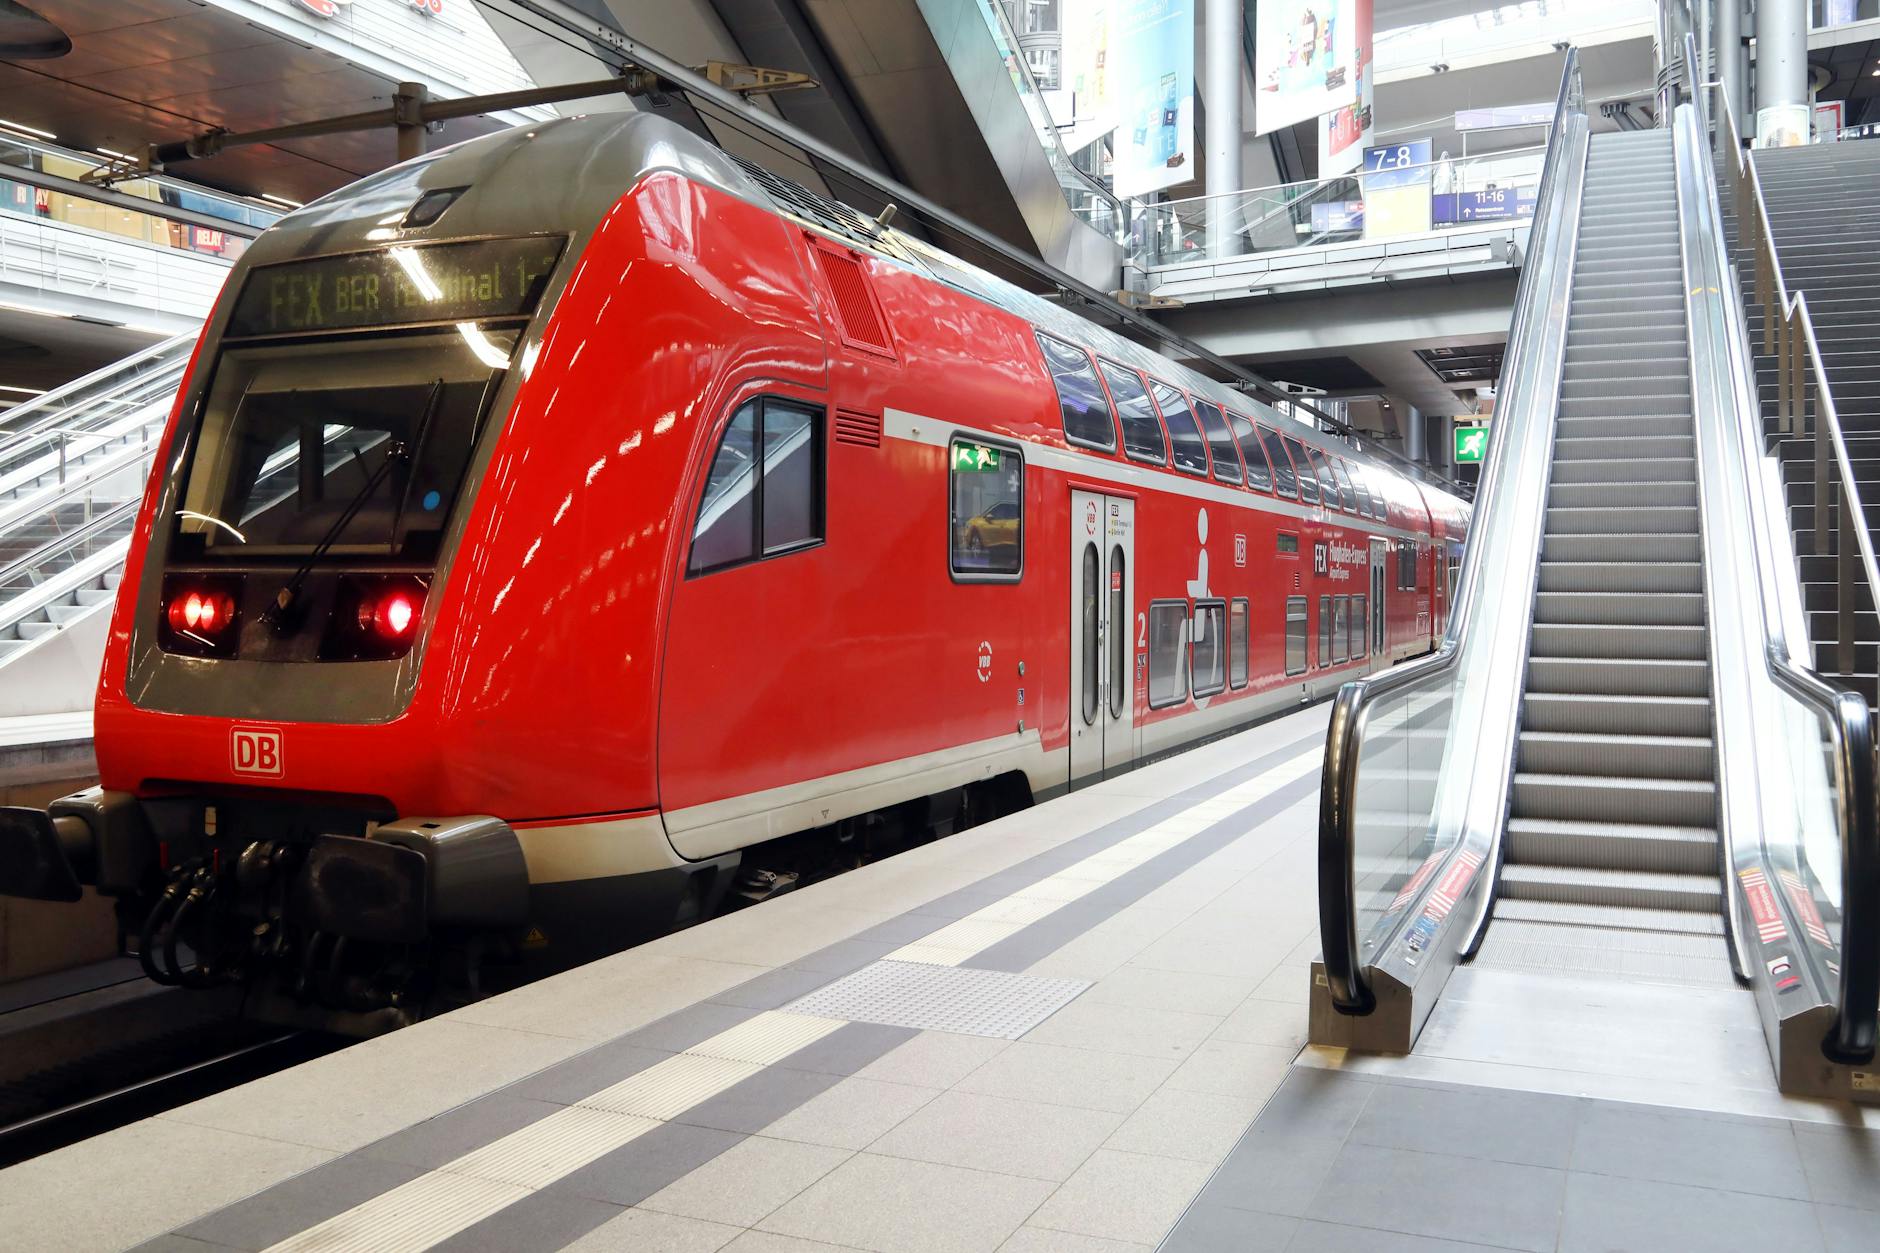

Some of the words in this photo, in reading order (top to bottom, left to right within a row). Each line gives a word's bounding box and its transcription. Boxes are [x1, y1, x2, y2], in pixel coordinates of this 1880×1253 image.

[1373, 146, 1411, 171] 7-8
[1475, 190, 1505, 204] 11-16
[196, 226, 223, 246] RELAY
[269, 273, 323, 328] FEX
[335, 273, 379, 313] BER
[1236, 540, 1245, 561] DB
[1314, 543, 1327, 574] FEX
[1137, 611, 1146, 648] 2
[979, 655, 991, 668] VBB
[236, 735, 278, 770] DB
